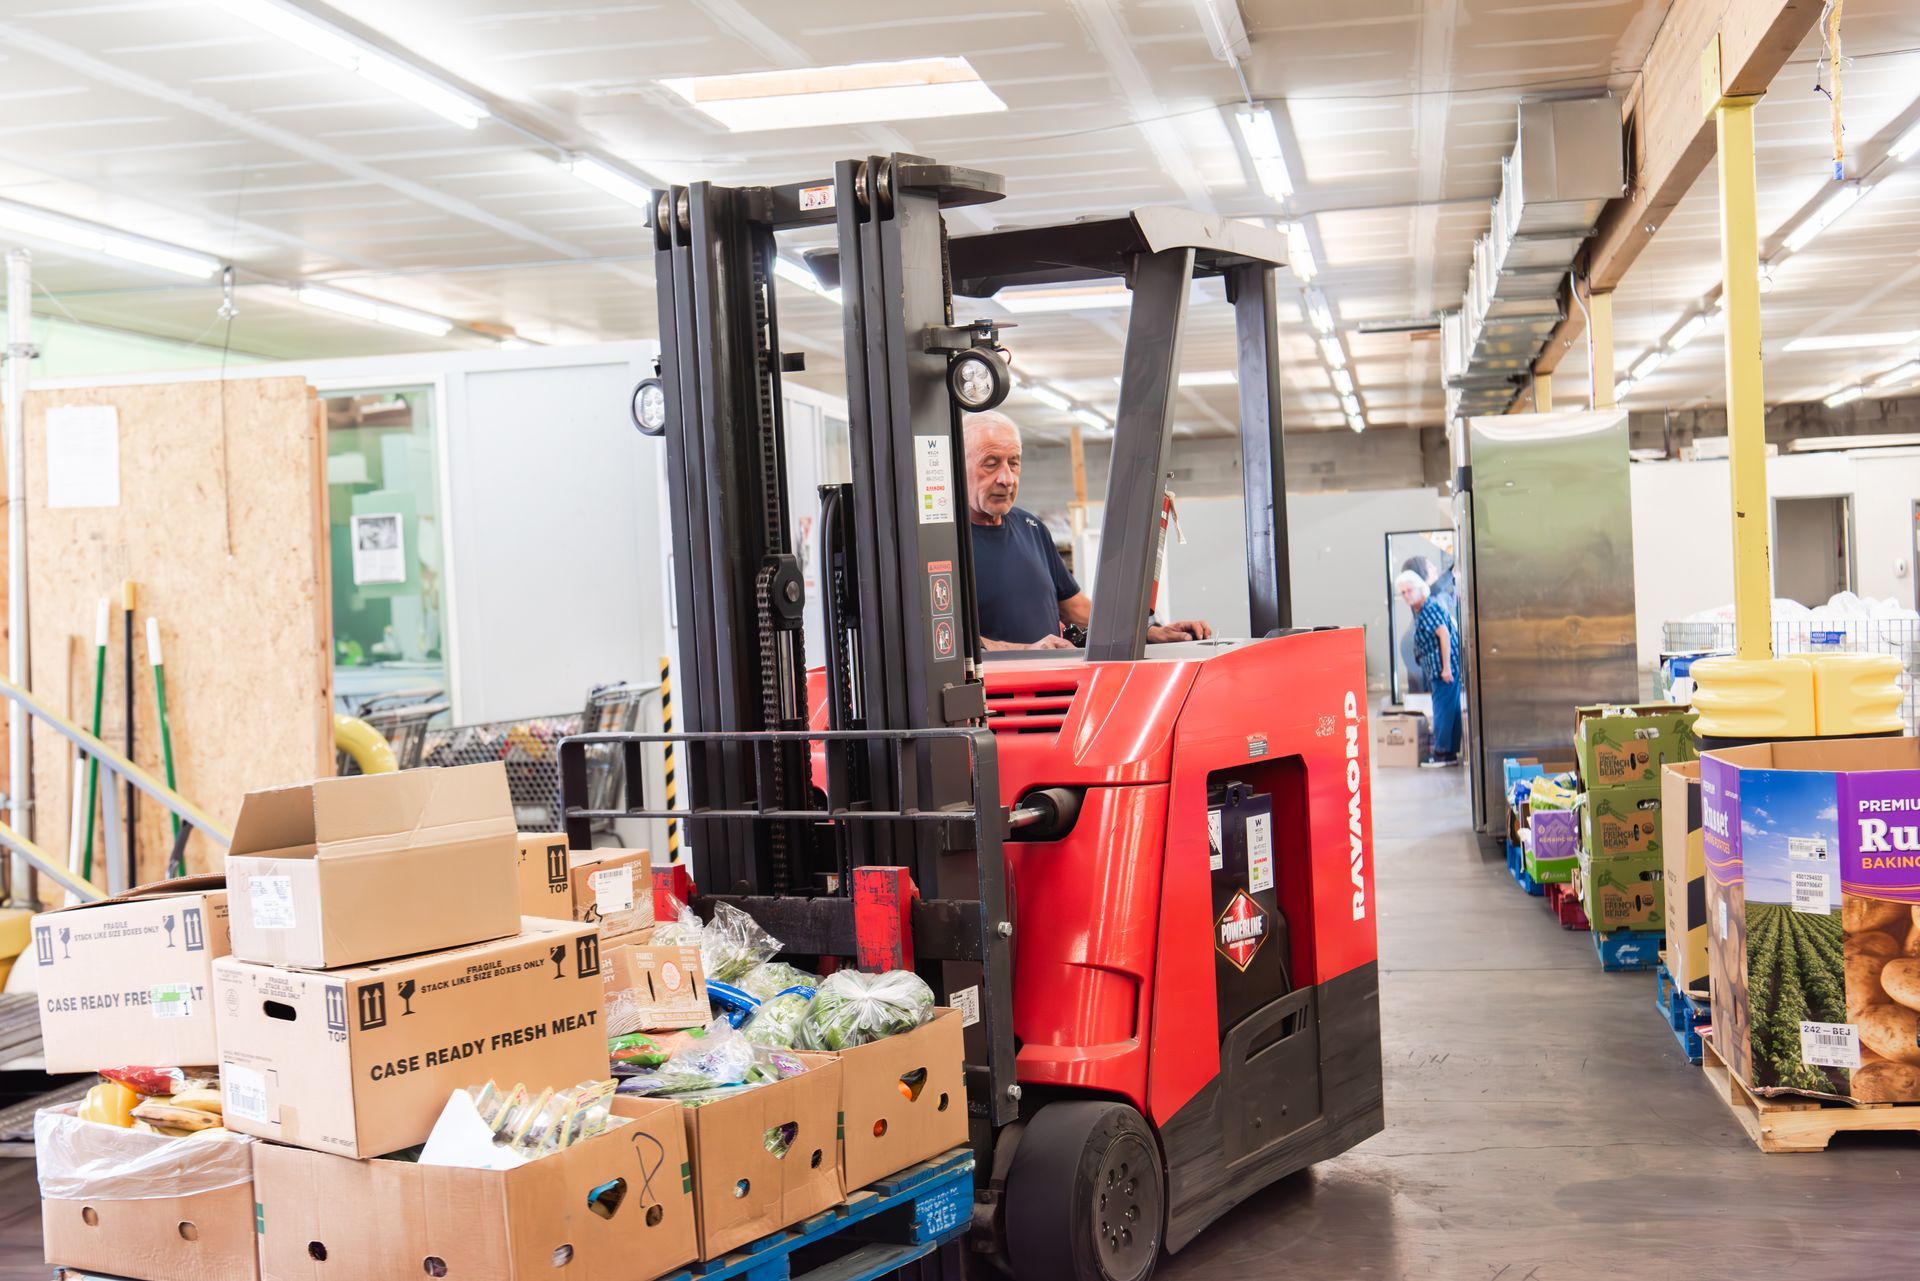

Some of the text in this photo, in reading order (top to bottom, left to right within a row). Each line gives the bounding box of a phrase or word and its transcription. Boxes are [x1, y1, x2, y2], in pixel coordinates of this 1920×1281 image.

[1600, 759, 1630, 768] FRENCH
[1600, 767, 1624, 776] BEANS
[1344, 690, 1366, 922] RAYMOND
[1703, 797, 1729, 838] Russet
[1604, 830, 1634, 839] FRENCH
[1604, 838, 1628, 848] BEANS
[548, 883, 568, 894] TOP
[1605, 901, 1635, 910] FRENCH
[1605, 909, 1630, 917] BEANS
[103, 921, 128, 930] FRAGILE
[1221, 915, 1263, 944] POWERLINE
[74, 925, 159, 942] STACK LIKE SIZE BOXES ONLY
[467, 960, 502, 975] FRAGILE
[420, 958, 545, 993] STACK LIKE SIZE BOXES ONLY
[47, 997, 77, 1013] CASE
[81, 993, 120, 1011] READY
[327, 1030, 347, 1042] TOP
[1804, 1025, 1821, 1034] 242
[1832, 1027, 1851, 1036] BEJ
[370, 1010, 598, 1082] CASE READY FRESH MEAT
